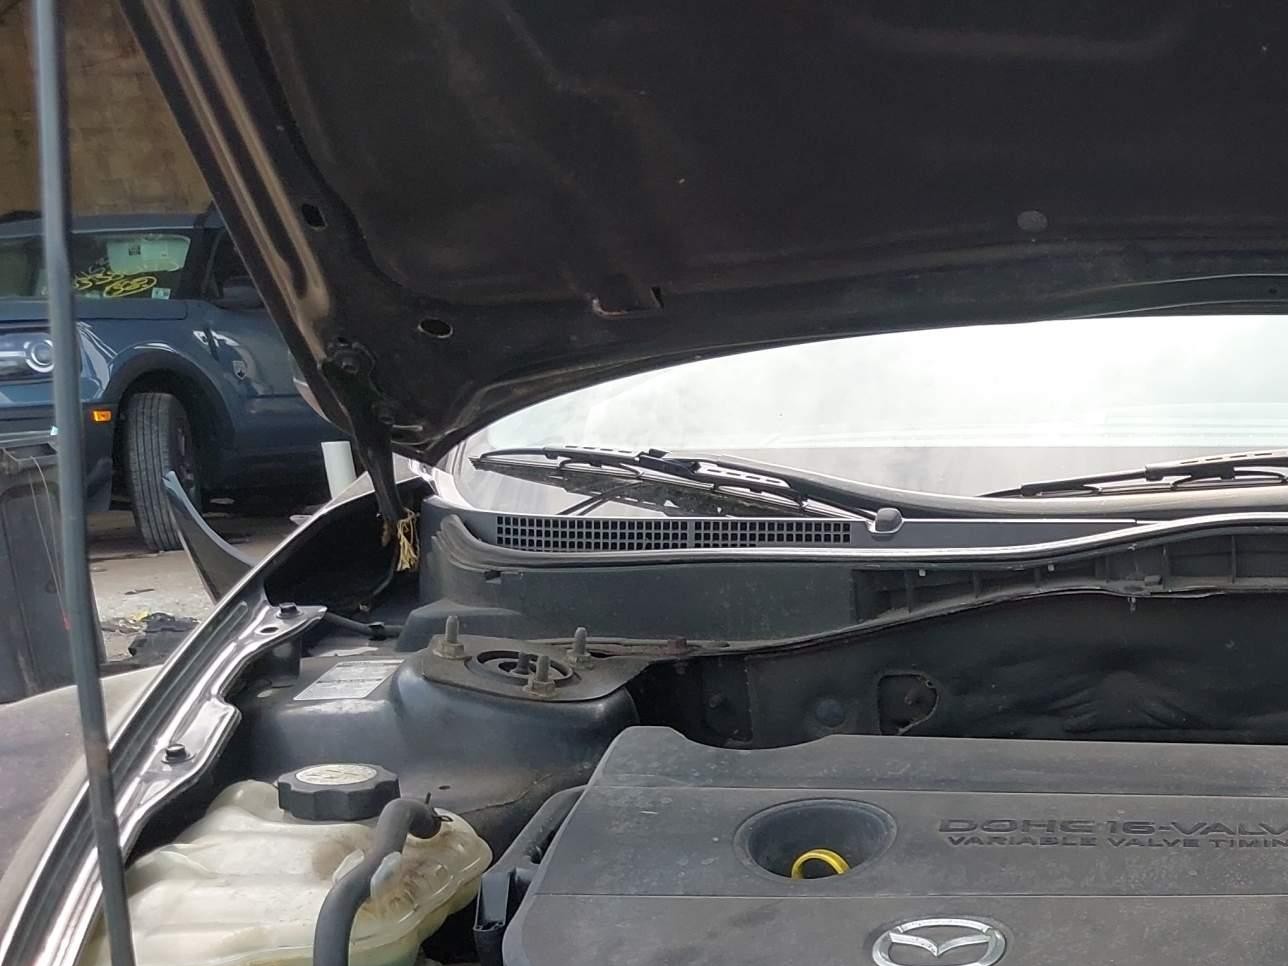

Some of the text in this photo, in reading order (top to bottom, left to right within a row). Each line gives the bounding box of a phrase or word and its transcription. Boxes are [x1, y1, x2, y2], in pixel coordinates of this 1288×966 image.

[938, 818, 1096, 833] DOHC
[947, 835, 1098, 848] VARIABLE
[1106, 837, 1200, 849] VALVE
